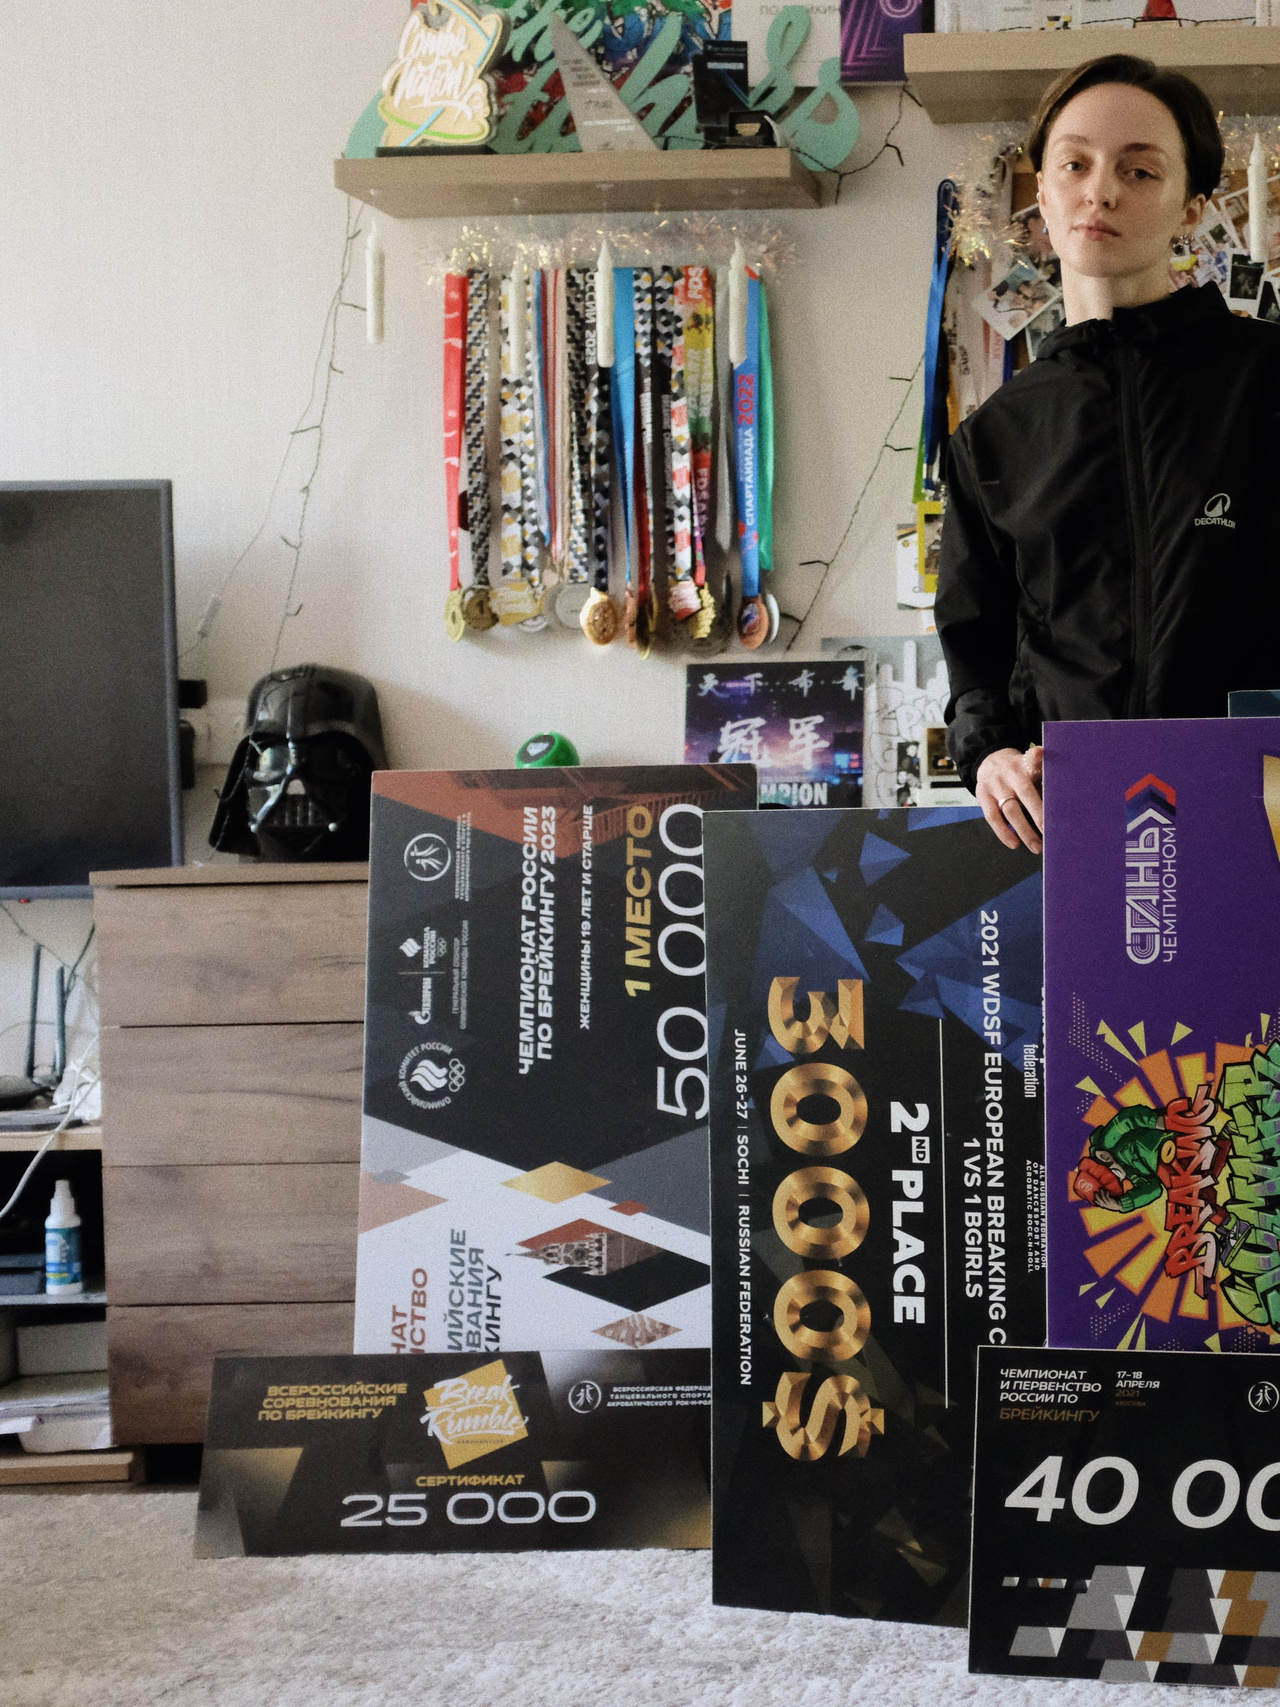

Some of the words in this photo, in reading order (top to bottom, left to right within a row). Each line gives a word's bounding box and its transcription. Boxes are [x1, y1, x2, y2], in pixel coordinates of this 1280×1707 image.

[738, 374, 754, 425] 2022
[744, 428, 754, 526] СПАРТАКИАДА
[1194, 518, 1236, 528] DECATHLON
[520, 806, 538, 912] РОССИИ
[540, 805, 556, 864] 2023
[581, 805, 594, 871] СТАРШЕ
[580, 888, 593, 918] ЛЕТ
[581, 874, 593, 885] И
[625, 804, 652, 969] МЕСТО
[656, 803, 705, 978] 000
[1125, 827, 1160, 964] СТАНЬ
[1162, 827, 1177, 962] ЧЕМПИОНОМ
[536, 867, 556, 1018] БРЕЙКИНГУ
[580, 921, 592, 938] 19
[980, 910, 1001, 966] 2021
[519, 917, 537, 1075] ЧЕМПИОНАТ
[579, 940, 593, 1030] ЖЕНЩИНЫ
[626, 979, 651, 998] 1
[981, 970, 1001, 1046] WDSF
[538, 1022, 553, 1060] ПО
[656, 1006, 709, 1121] 50
[734, 1028, 748, 1071] JUNE
[735, 1073, 749, 1119] 26-27
[1022, 1043, 1039, 1098] federation
[963, 1137, 980, 1148] 1
[983, 1051, 1004, 1188] EUROPEAN
[736, 1134, 750, 1186] SOCHI
[963, 1152, 981, 1187] VS
[1033, 1162, 1038, 1175] OF
[761, 975, 885, 1463] 3000$
[963, 1194, 981, 1204] 1
[737, 1204, 752, 1276] RUSSIAN
[891, 1169, 926, 1325] PLACE
[964, 1210, 983, 1299] BGIRLS
[986, 1195, 1006, 1321] BREAKING
[738, 1280, 753, 1386] FEDERATION
[267, 1381, 408, 1396] ВСЕРОССИЙСКИЕ
[434, 1374, 520, 1405] Break
[1000, 1369, 1087, 1380] ЧЕМПИОНАТ
[1000, 1381, 1010, 1390] И
[1013, 1381, 1102, 1392] ПЕРВЕНСТВО
[1000, 1392, 1055, 1403] РОССИИ
[1058, 1394, 1079, 1403] ПО
[1115, 1380, 1160, 1388] АПРЕЛЯ
[258, 1410, 282, 1421] ПО
[285, 1407, 383, 1420] БРЕЙКИНГУ
[262, 1396, 397, 1408] СОРЕВНОВАНИЯ
[420, 1404, 529, 1444] Rumble
[1000, 1405, 1100, 1422] БРЕЙКИНГУ
[414, 1474, 526, 1487] СЕРТИФИКАТ
[1003, 1455, 1140, 1526] 40
[339, 1493, 429, 1528] 25
[446, 1490, 598, 1525] 000
